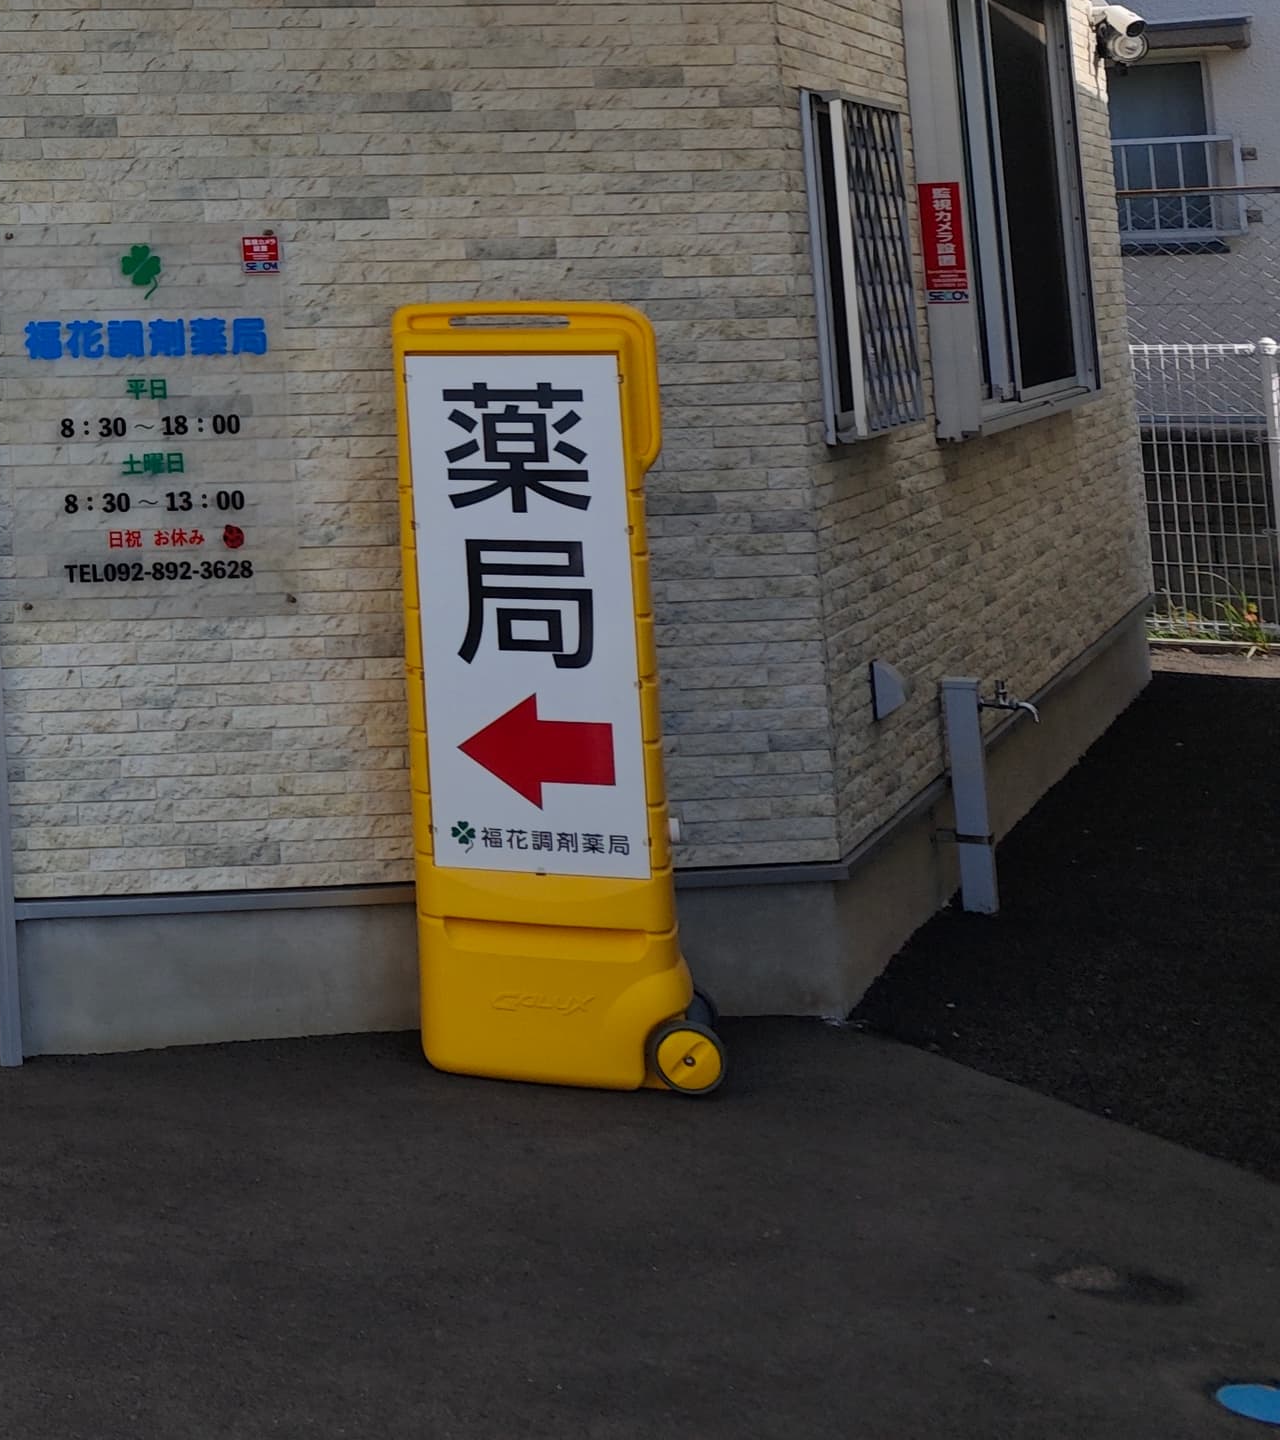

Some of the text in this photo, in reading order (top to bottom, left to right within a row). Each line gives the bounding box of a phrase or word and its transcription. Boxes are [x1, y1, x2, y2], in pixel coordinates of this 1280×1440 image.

[24, 317, 268, 360] 福花調剤薬局
[126, 379, 168, 400] 平日
[121, 452, 185, 475] 土曜日
[442, 382, 594, 669] 薬局
[108, 528, 205, 548] 日祝 お休み
[64, 560, 254, 583] TEL092-892-3628
[481, 826, 631, 856] 福花調剤薬局
